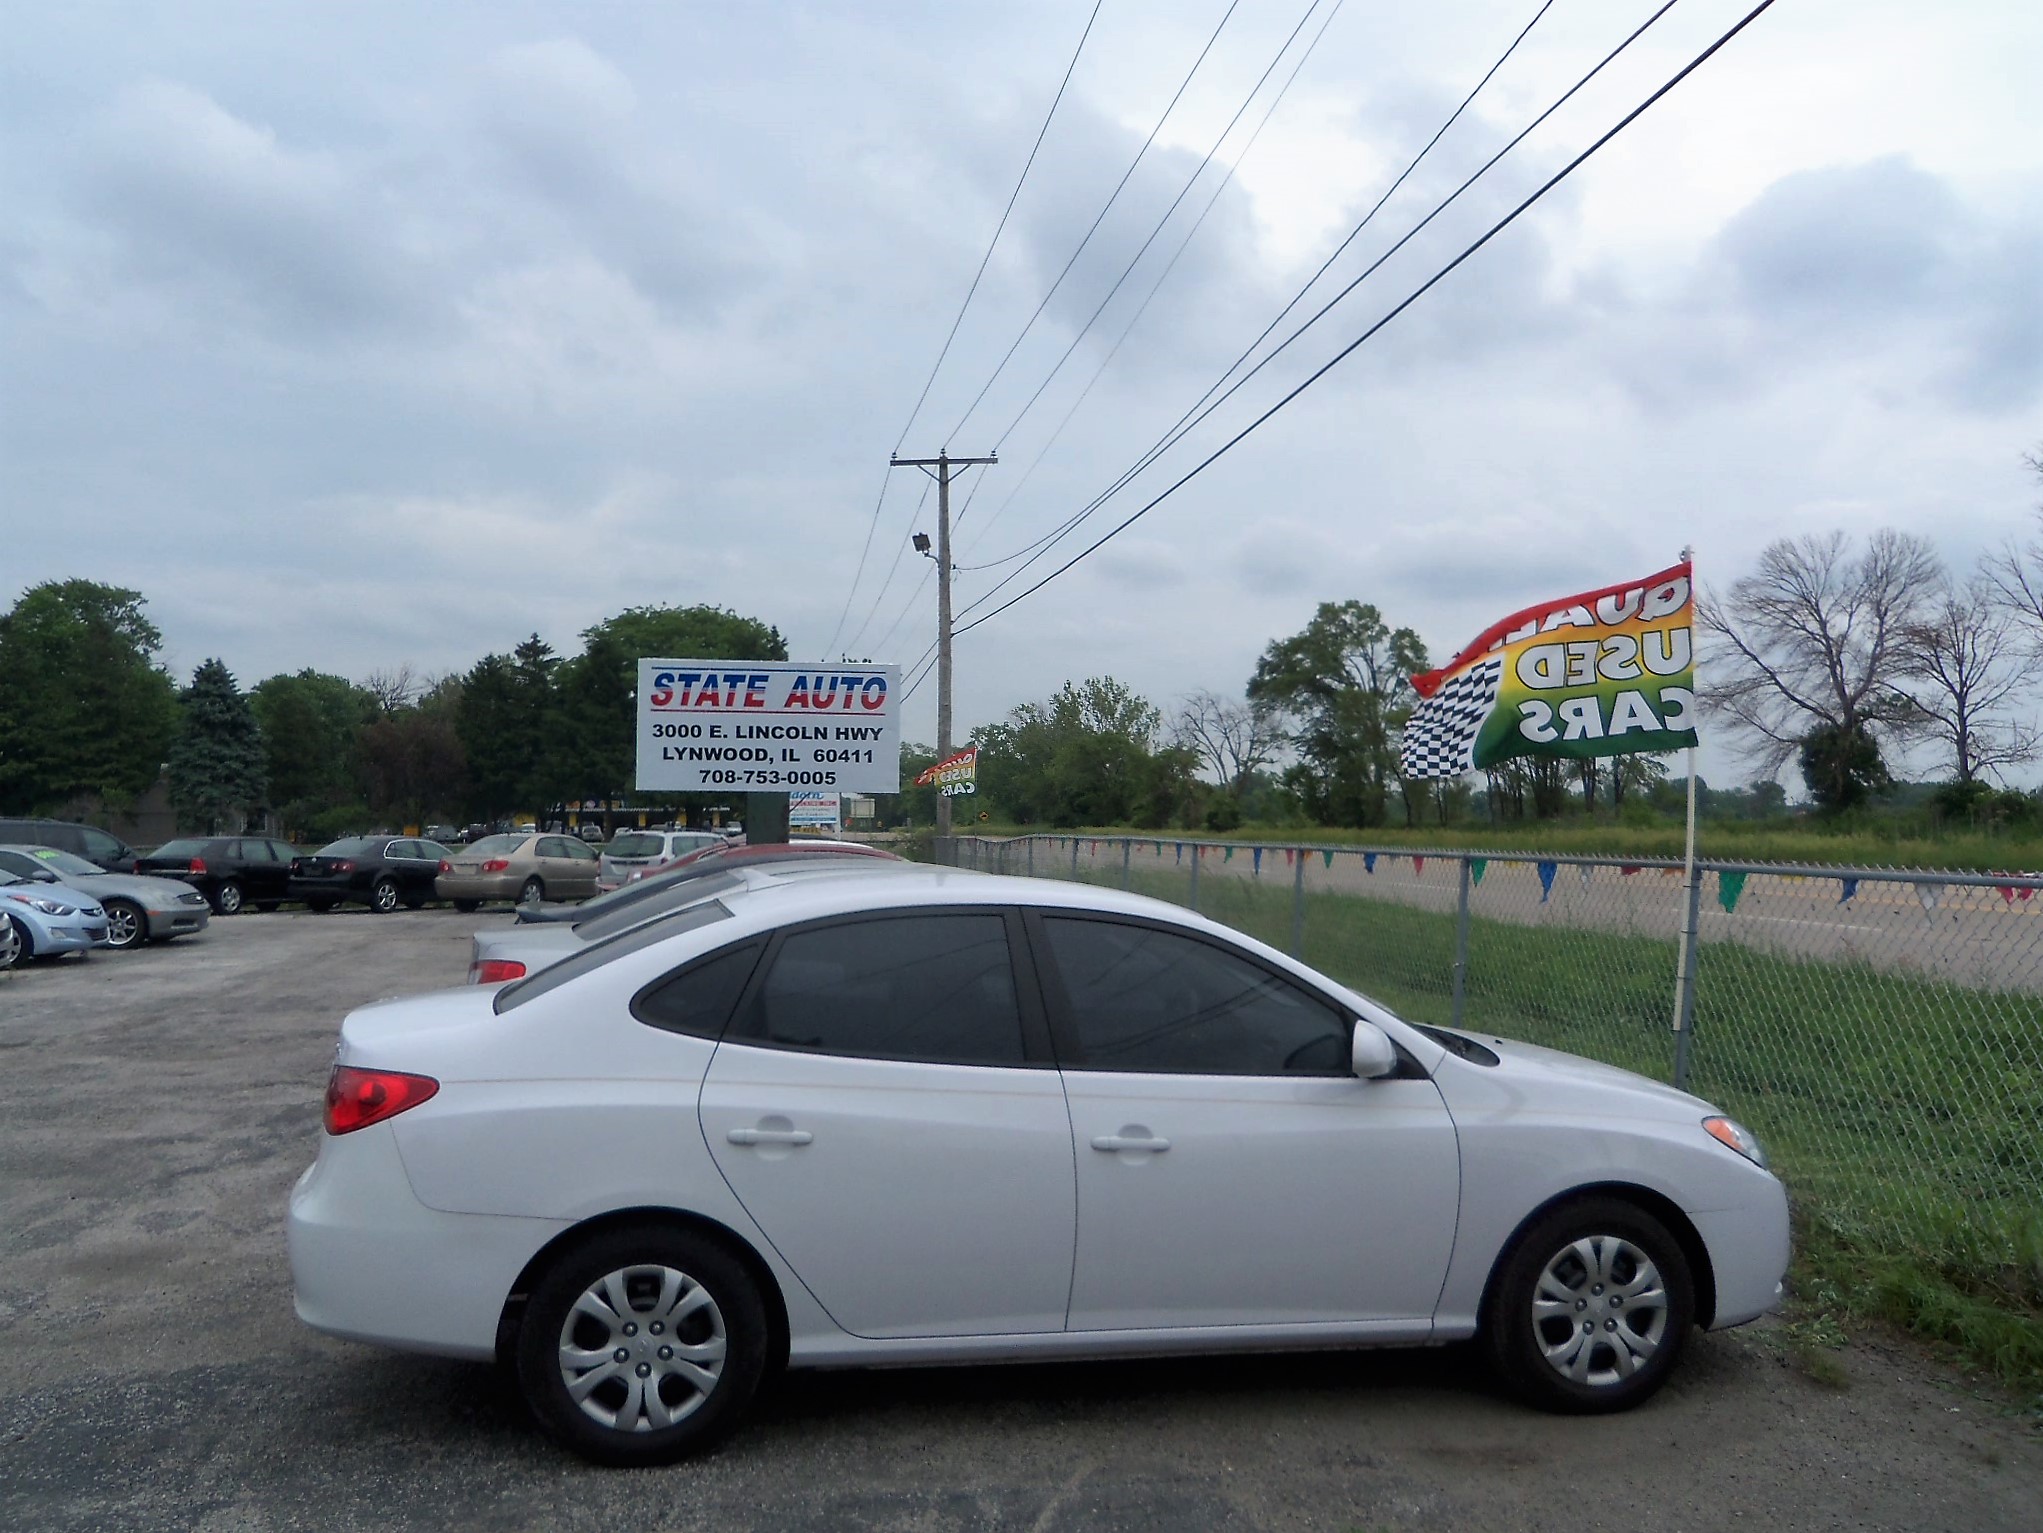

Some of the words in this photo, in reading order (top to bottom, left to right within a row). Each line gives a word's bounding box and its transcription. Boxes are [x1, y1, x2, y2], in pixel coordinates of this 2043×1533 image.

[651, 672, 769, 707] STATE
[784, 675, 887, 710] AUTO
[652, 724, 702, 738] 3000
[709, 724, 728, 738] E.
[736, 725, 828, 740] LINCOLN
[835, 727, 883, 741] HWY
[663, 746, 774, 764] LYNWOOD,
[782, 748, 800, 762] IL
[813, 748, 873, 763] 60411
[699, 769, 836, 785] 708-753-0005
